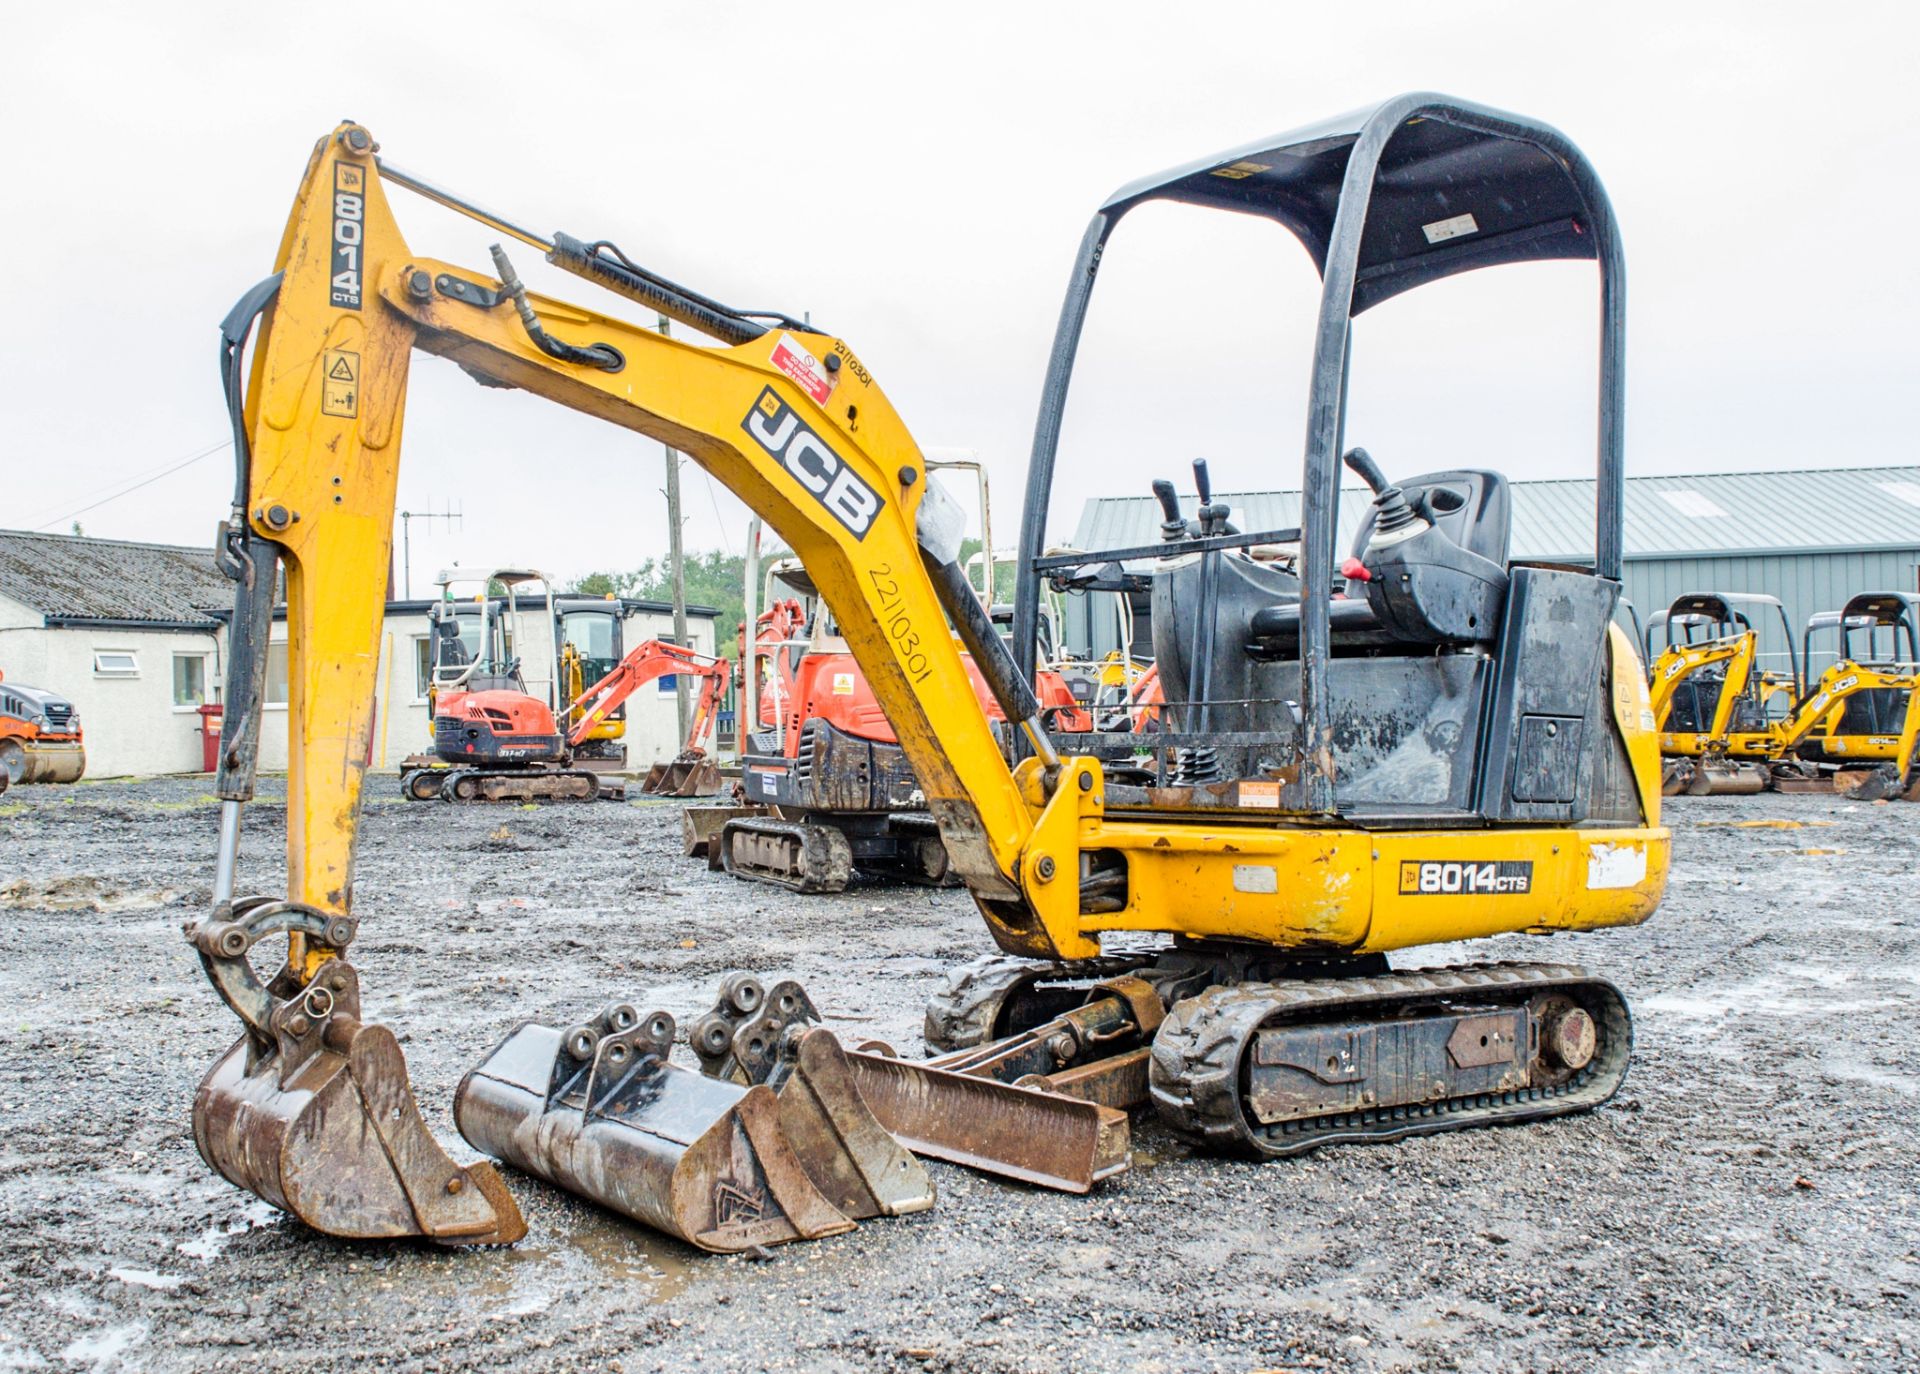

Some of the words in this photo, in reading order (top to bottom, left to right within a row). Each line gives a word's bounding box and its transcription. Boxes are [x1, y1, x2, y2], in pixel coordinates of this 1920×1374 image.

[333, 193, 362, 294] 8014
[332, 292, 359, 305] CTS
[749, 410, 877, 533] JCB
[869, 562, 933, 684] 22110301
[1665, 657, 1685, 679] JCB
[1832, 676, 1857, 693] JCB
